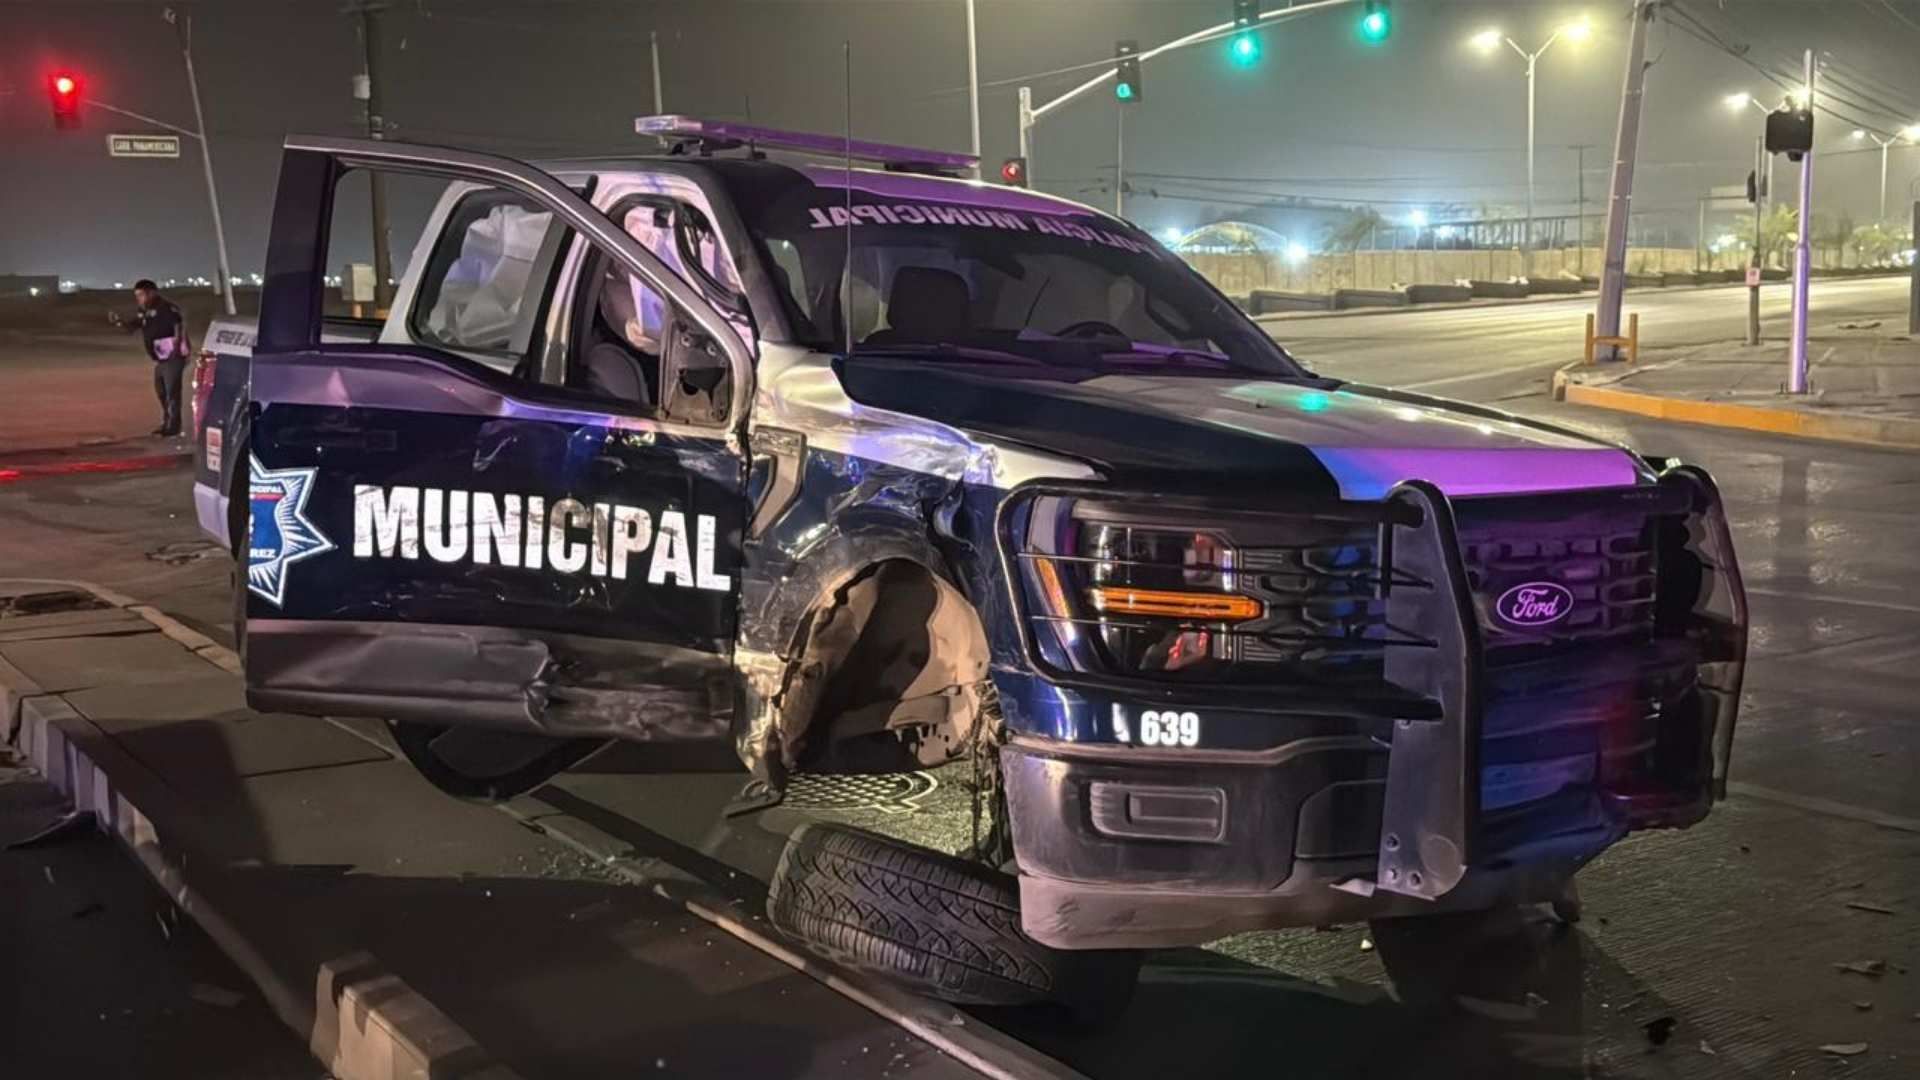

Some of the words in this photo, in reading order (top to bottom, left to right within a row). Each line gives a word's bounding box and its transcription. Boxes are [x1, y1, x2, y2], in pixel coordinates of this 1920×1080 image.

[352, 483, 732, 592] MUNICIPAL
[1512, 587, 1560, 619] Ford
[1140, 710, 1200, 747] 639
